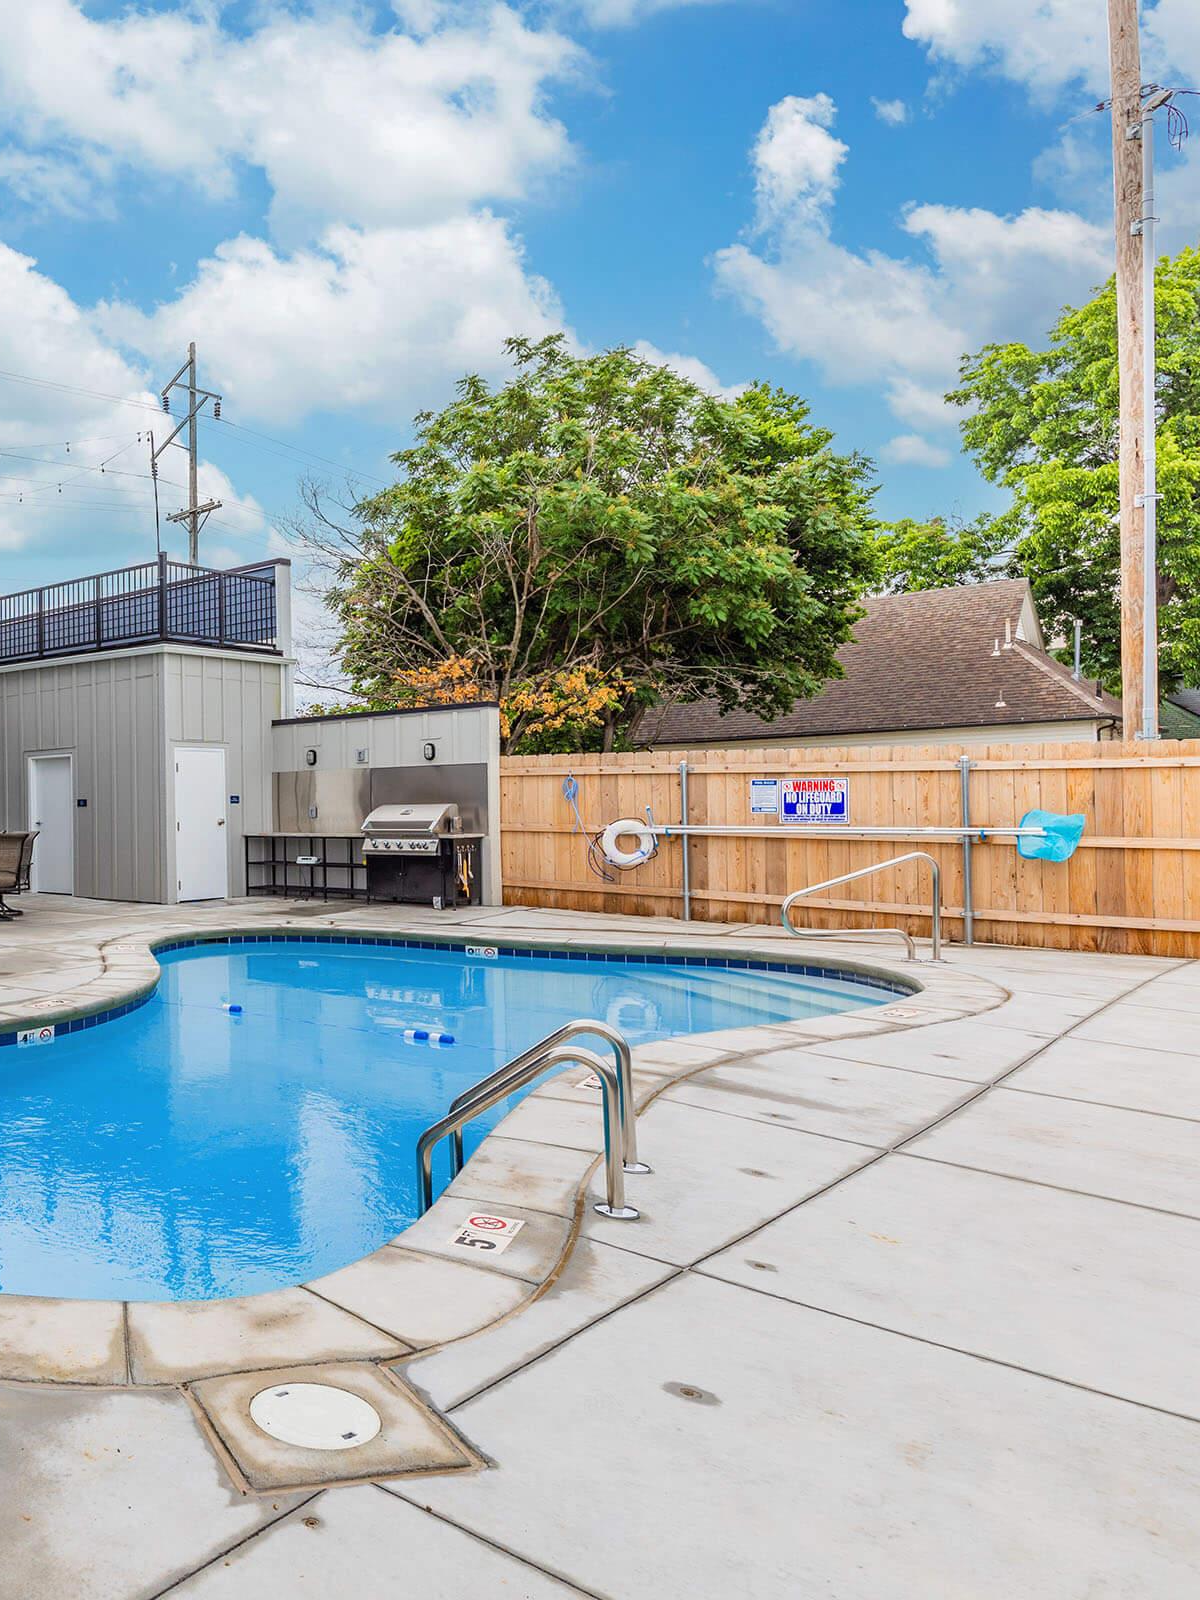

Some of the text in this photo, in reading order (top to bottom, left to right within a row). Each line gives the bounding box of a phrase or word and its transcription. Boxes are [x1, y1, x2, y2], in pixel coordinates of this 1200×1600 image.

[793, 780, 835, 792] WARNING
[786, 792, 797, 803] NO
[799, 792, 842, 803] LIFEGUARD
[796, 803, 832, 814] ON DUTY
[454, 1236, 497, 1250] 5
